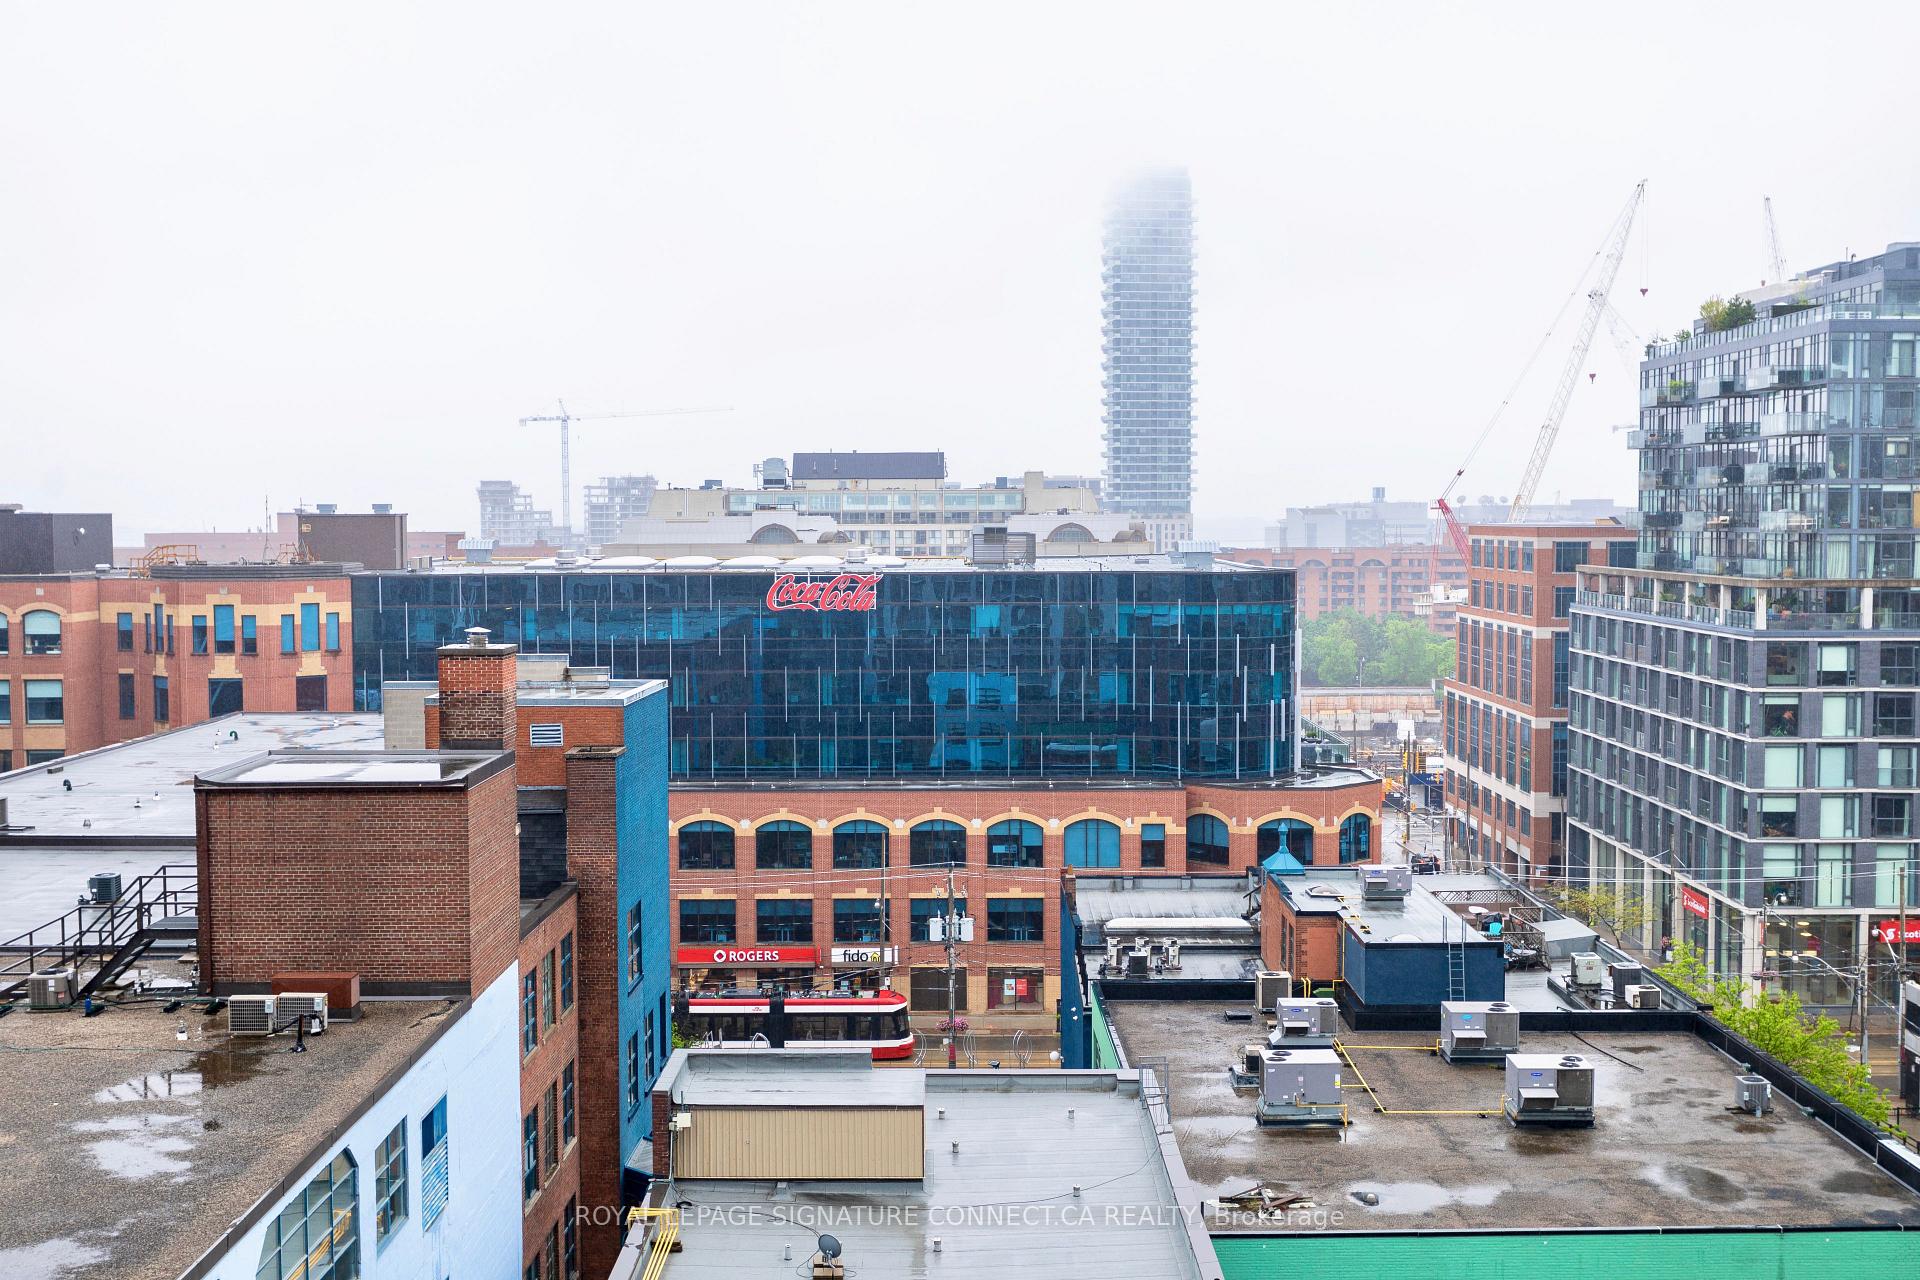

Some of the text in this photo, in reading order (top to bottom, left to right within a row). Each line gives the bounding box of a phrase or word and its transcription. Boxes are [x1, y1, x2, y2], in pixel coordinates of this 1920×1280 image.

[766, 573, 884, 611] Coca-Cola
[729, 950, 779, 962] ROGERS
[843, 949, 869, 962] fido
